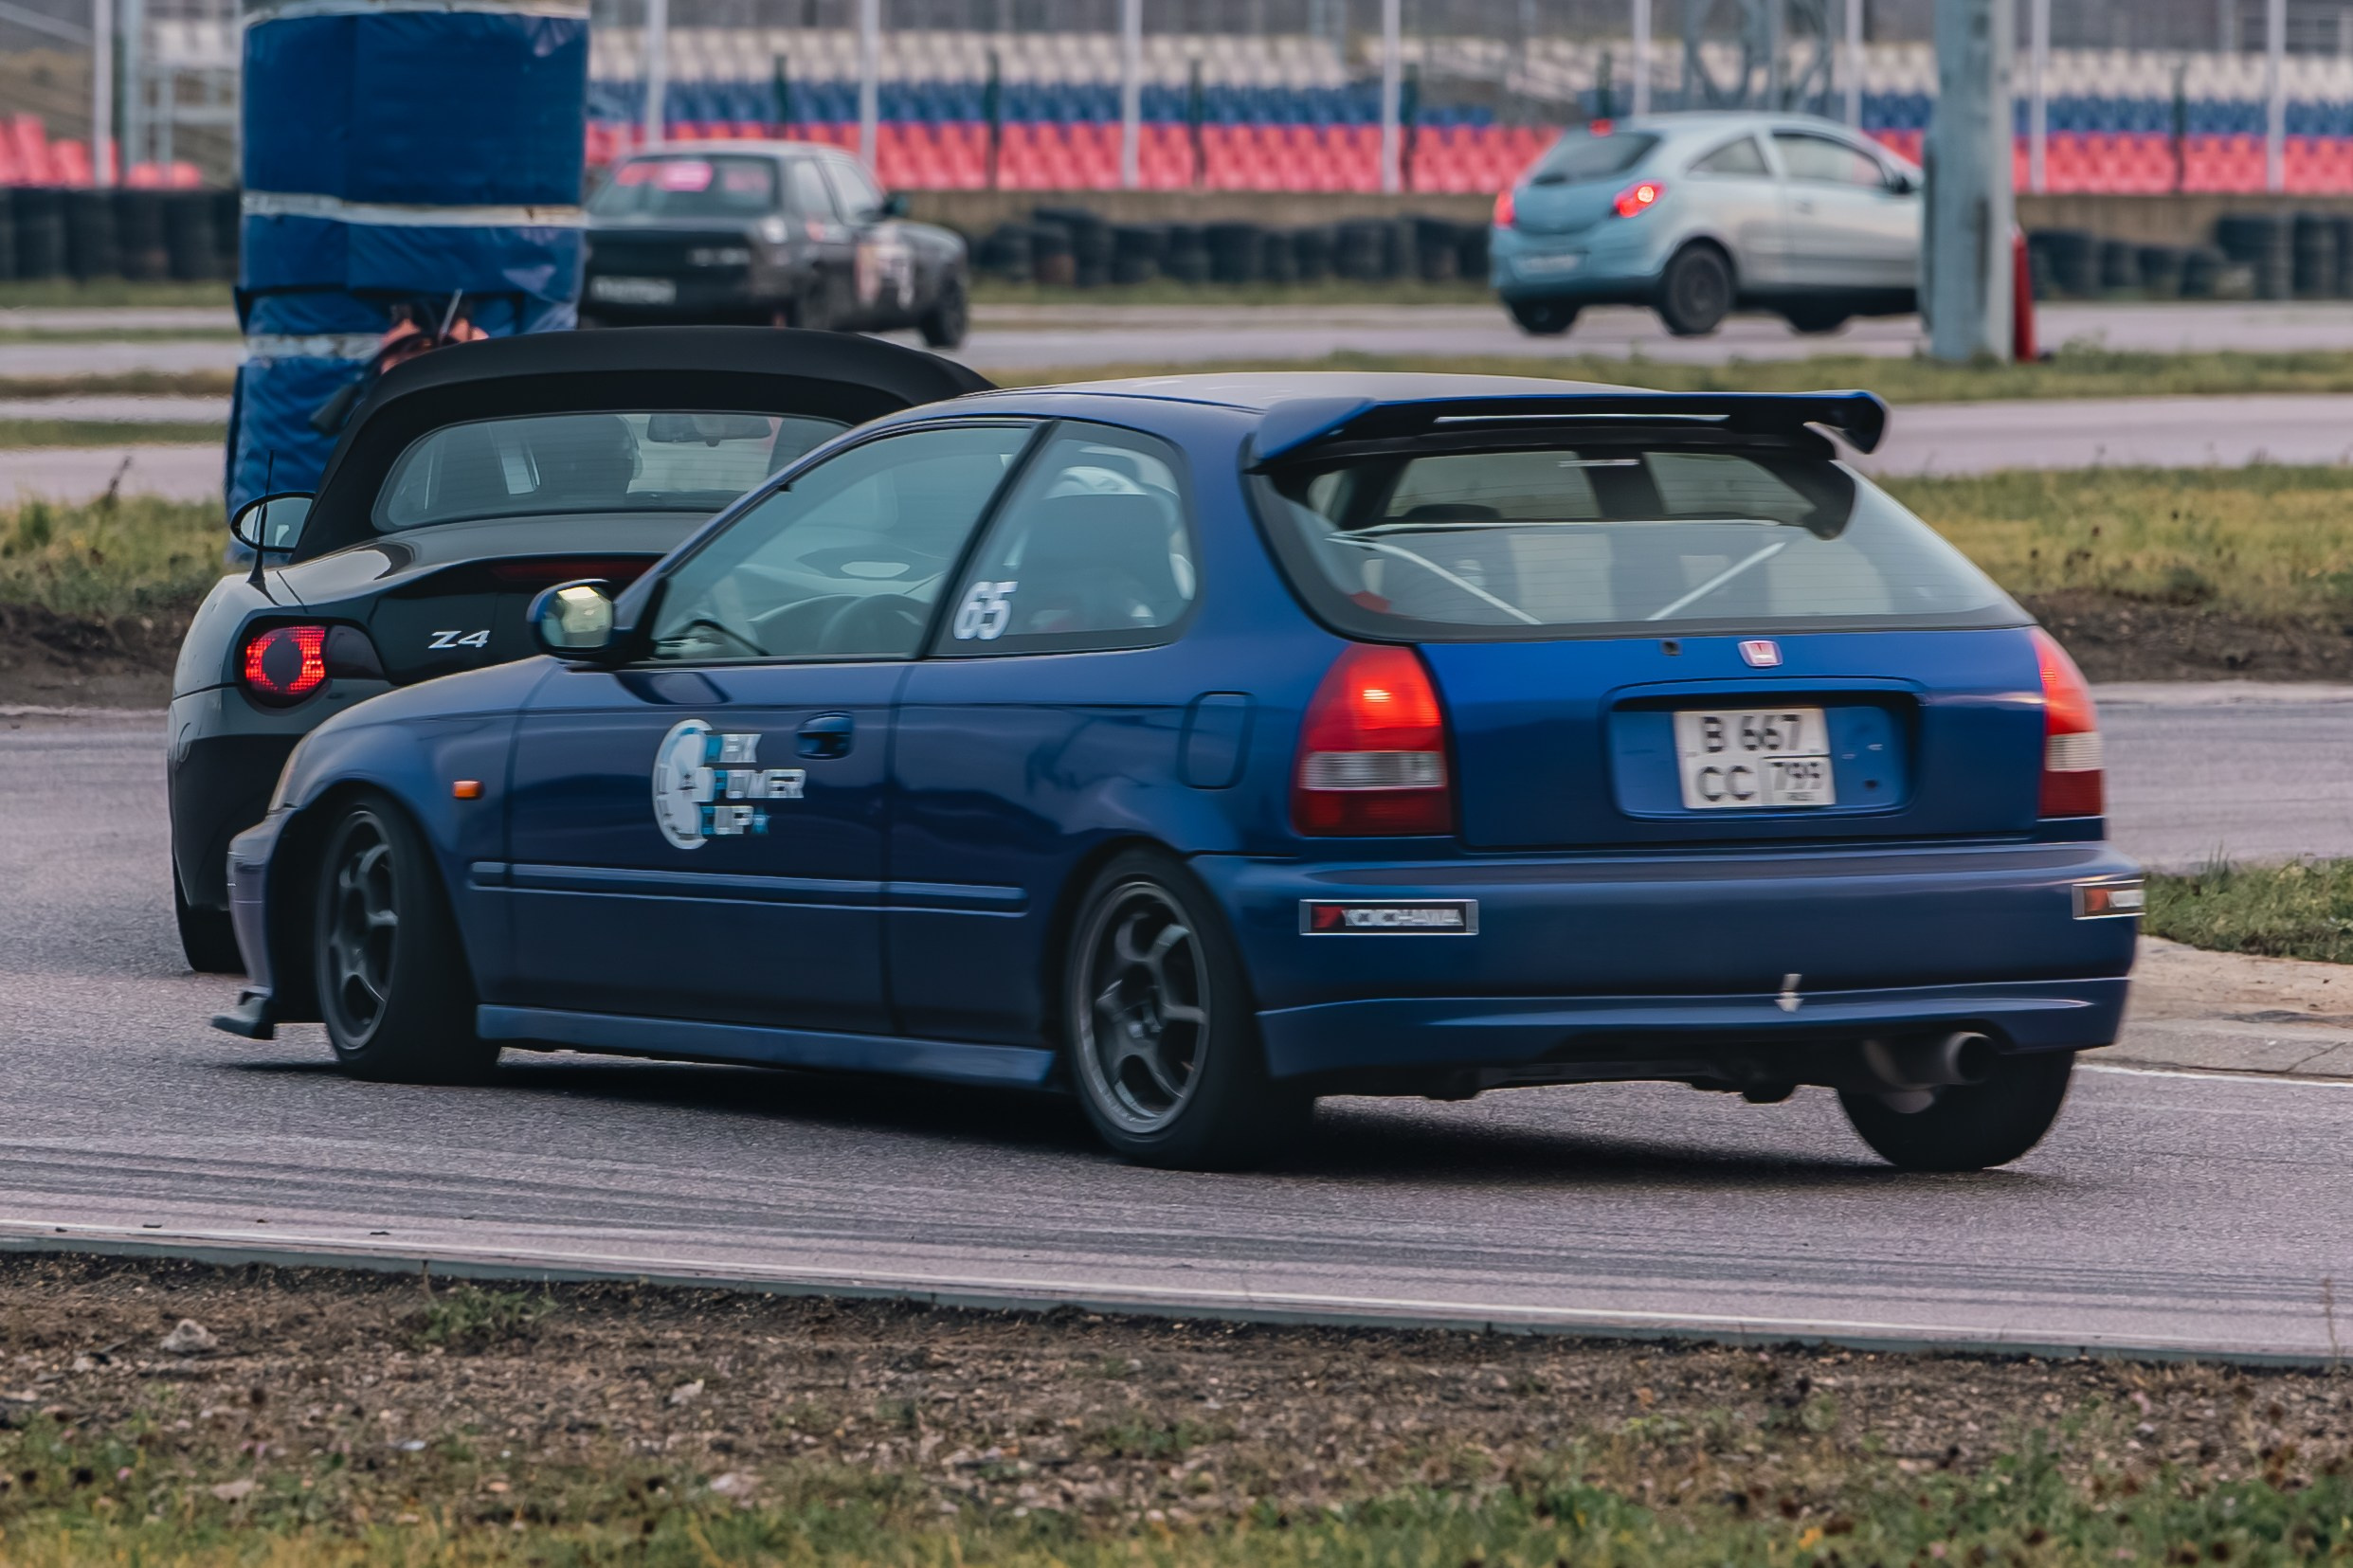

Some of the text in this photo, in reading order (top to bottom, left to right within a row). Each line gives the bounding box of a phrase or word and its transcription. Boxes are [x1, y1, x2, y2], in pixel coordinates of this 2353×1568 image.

[953, 581, 1019, 640] 65
[427, 630, 491, 649] Z4
[1741, 714, 1801, 750] 667
[713, 769, 805, 799] POWER
[1696, 762, 1822, 802] CC 799
